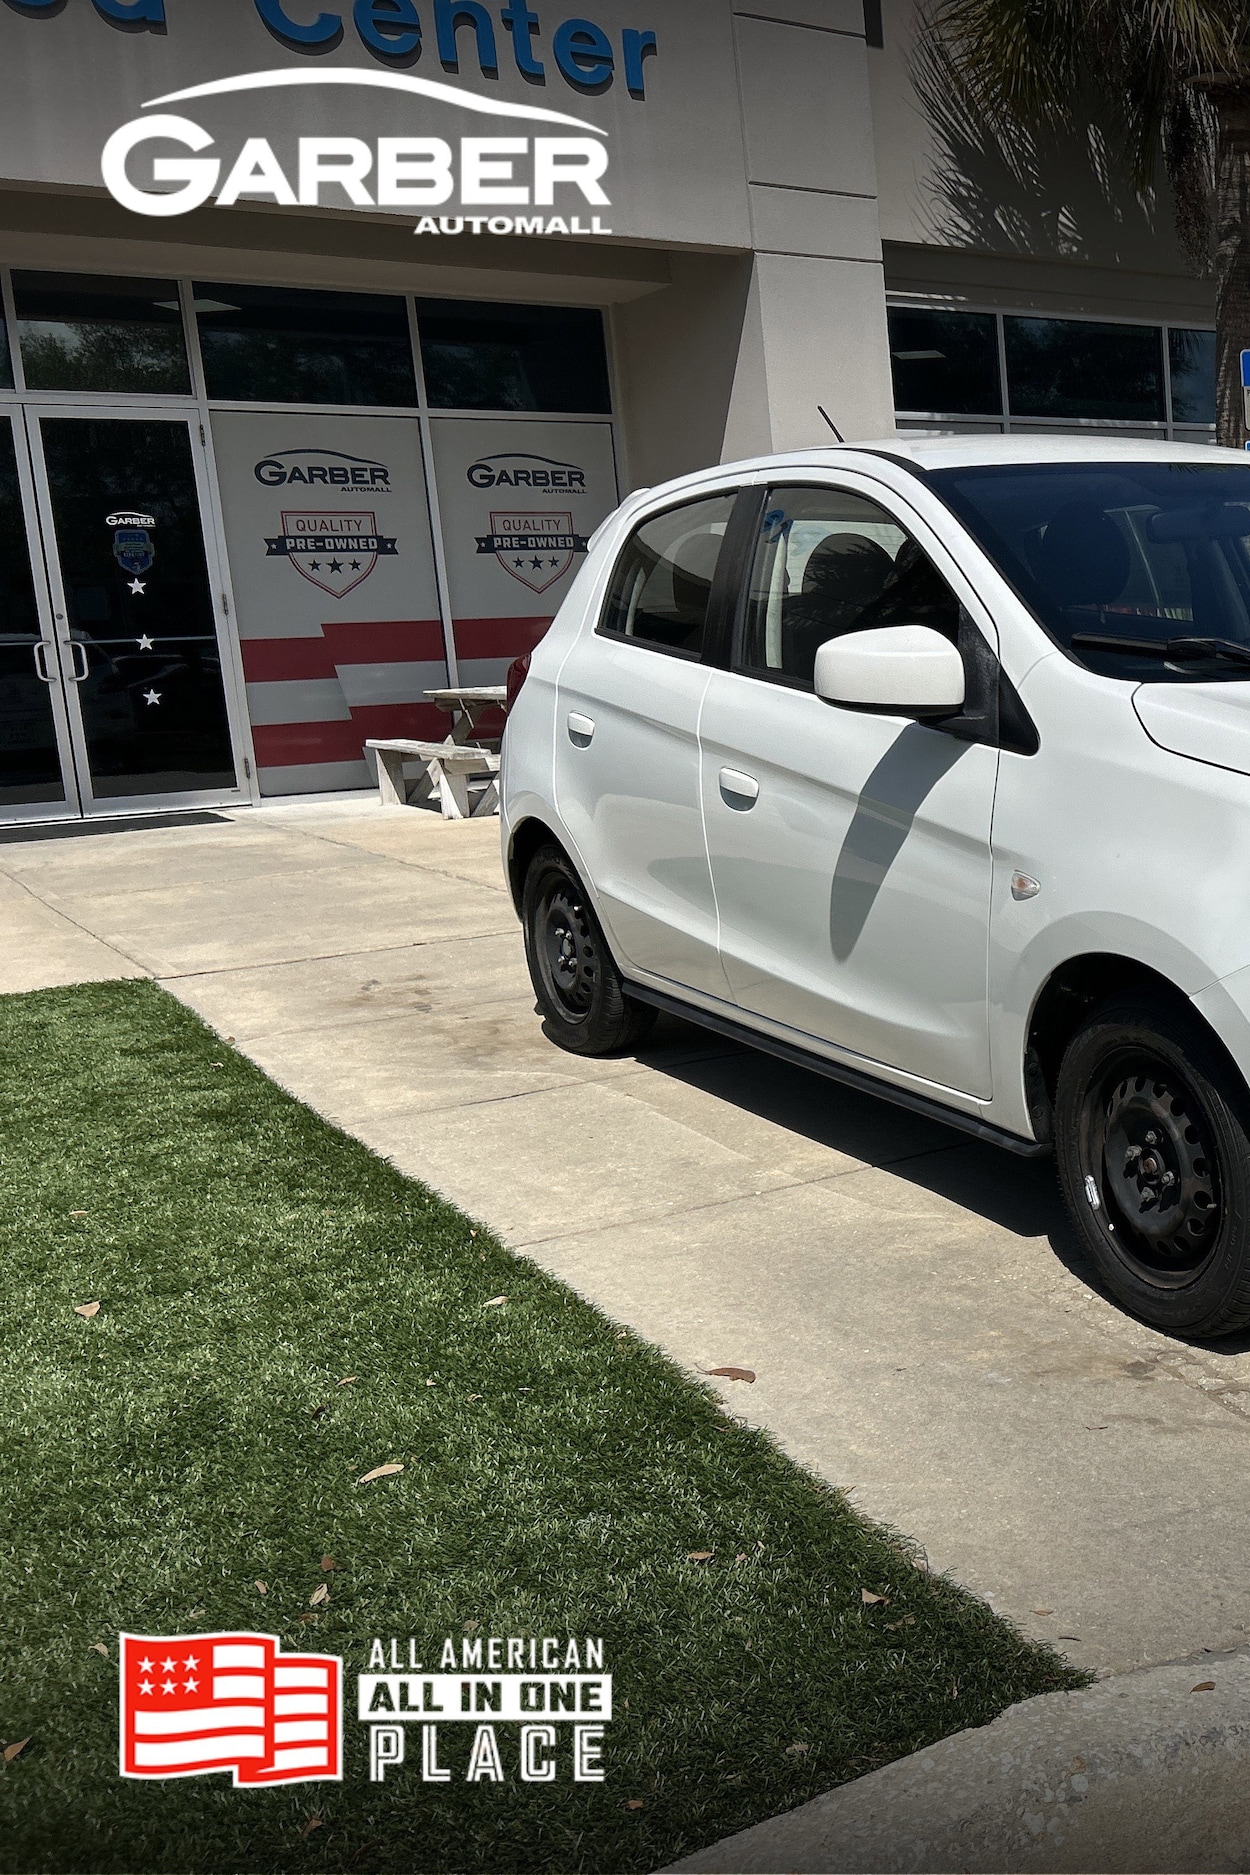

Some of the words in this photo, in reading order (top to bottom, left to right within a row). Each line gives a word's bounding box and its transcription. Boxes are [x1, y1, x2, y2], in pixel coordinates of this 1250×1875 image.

[255, 460, 391, 486] GARBER
[467, 464, 586, 488] GARBER
[106, 516, 155, 526] GARBER
[296, 519, 362, 532] QUALITY
[502, 520, 561, 531] QUALITY
[285, 538, 378, 550] PRE-OWNED
[493, 537, 575, 548] PRE-OWNED
